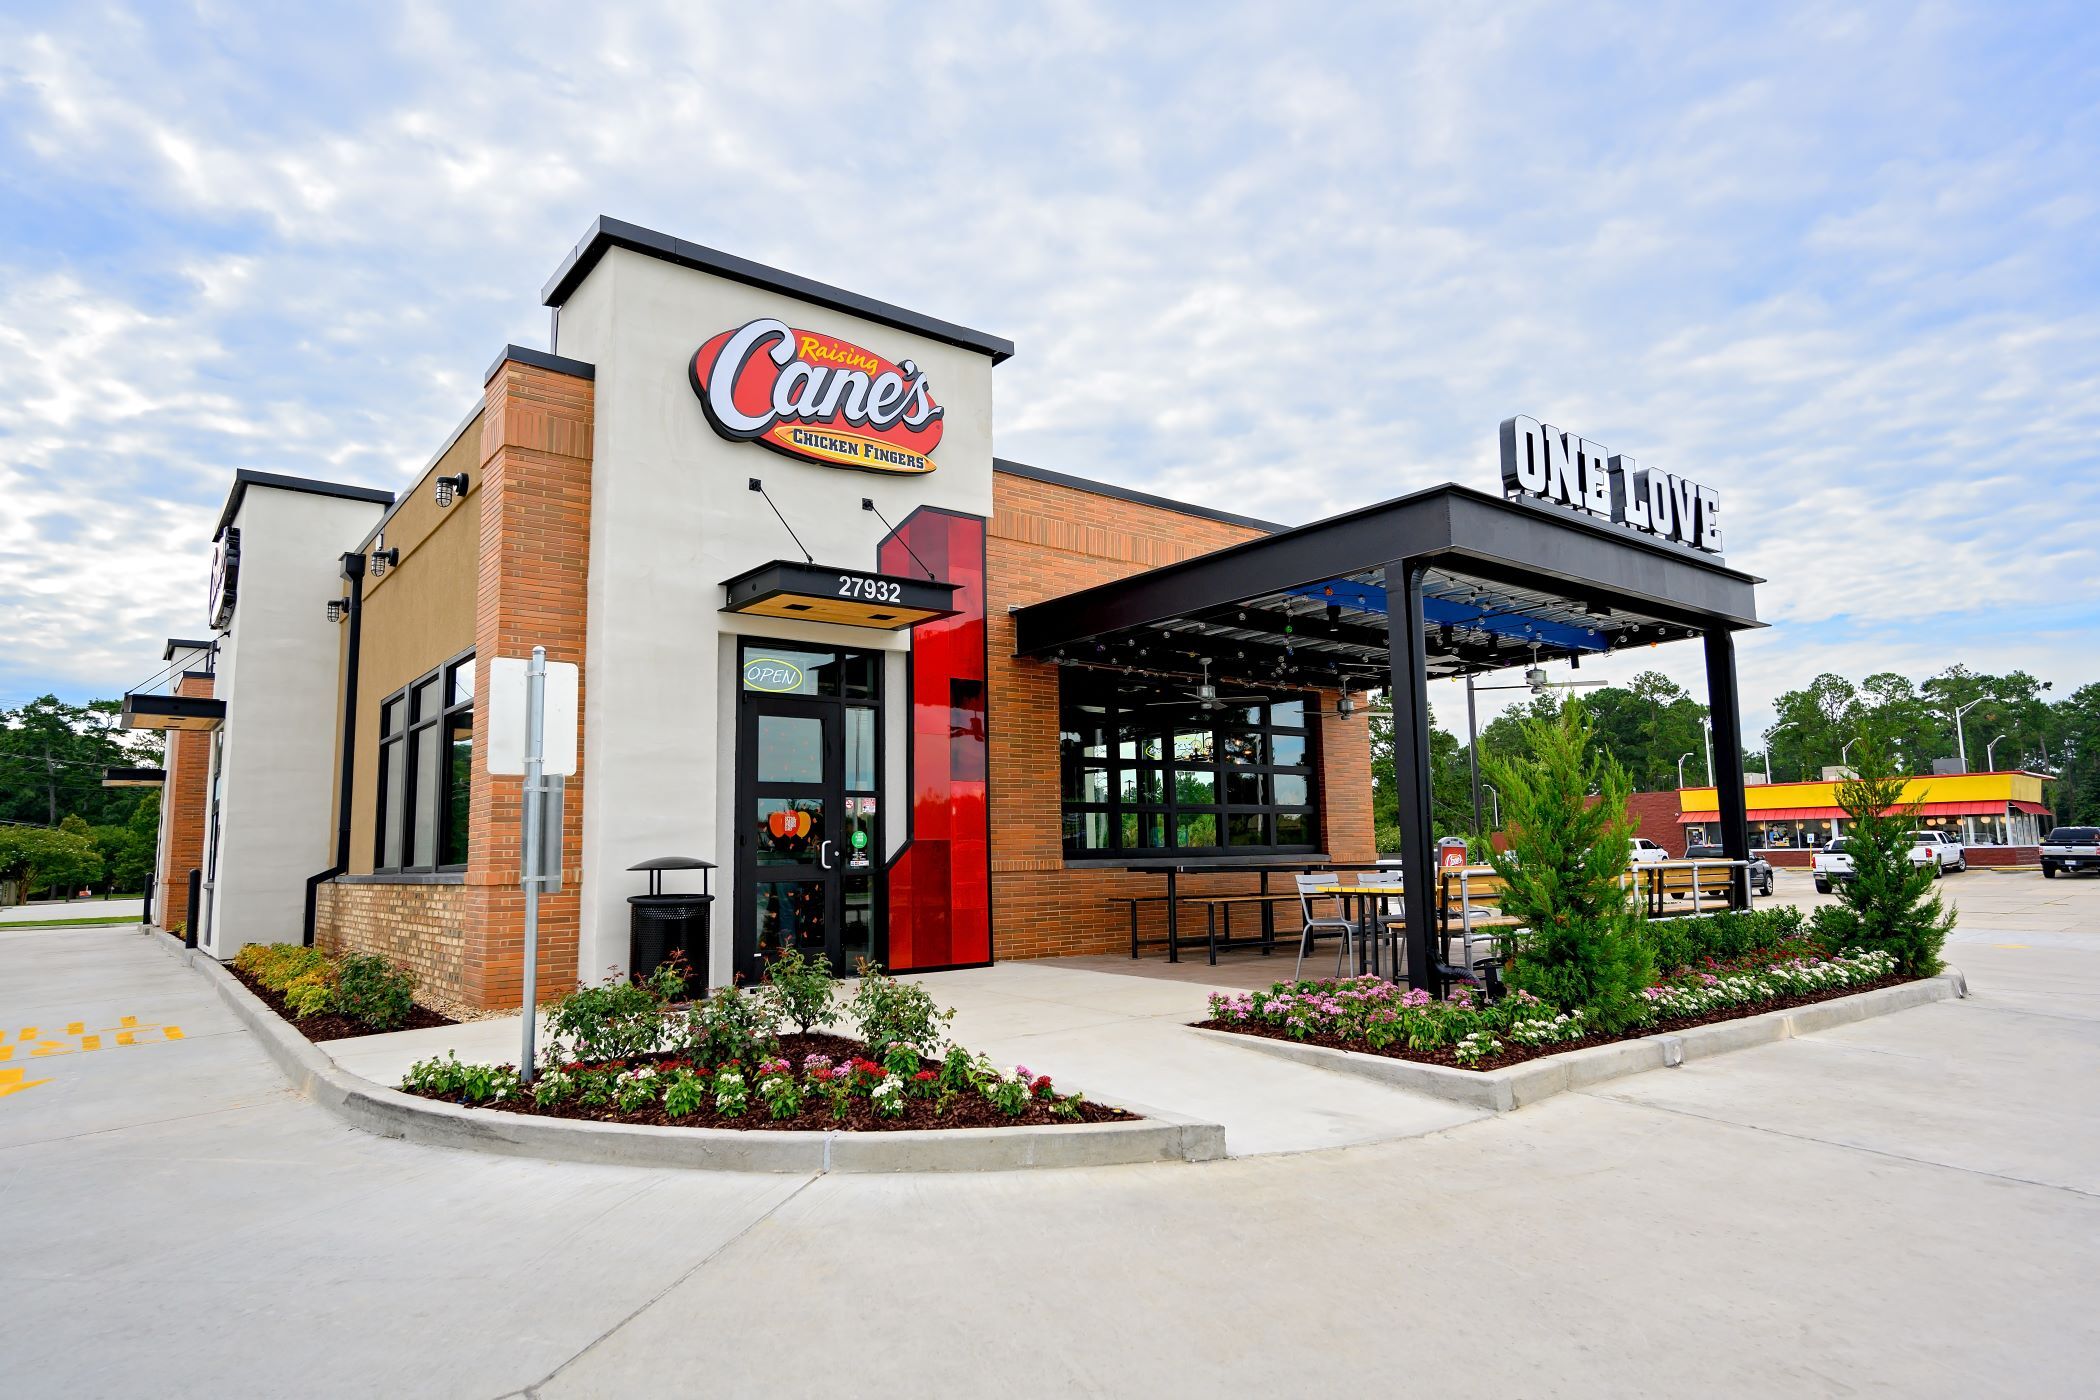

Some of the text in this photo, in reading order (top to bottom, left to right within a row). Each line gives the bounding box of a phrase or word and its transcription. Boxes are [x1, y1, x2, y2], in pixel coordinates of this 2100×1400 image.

[710, 319, 944, 431] Cane's
[800, 336, 878, 376] Raising
[792, 428, 925, 470] CHICKEN FINGERS
[1500, 414, 1723, 552] ONE LOVE
[838, 575, 901, 603] 27932
[747, 666, 796, 685] OPEN
